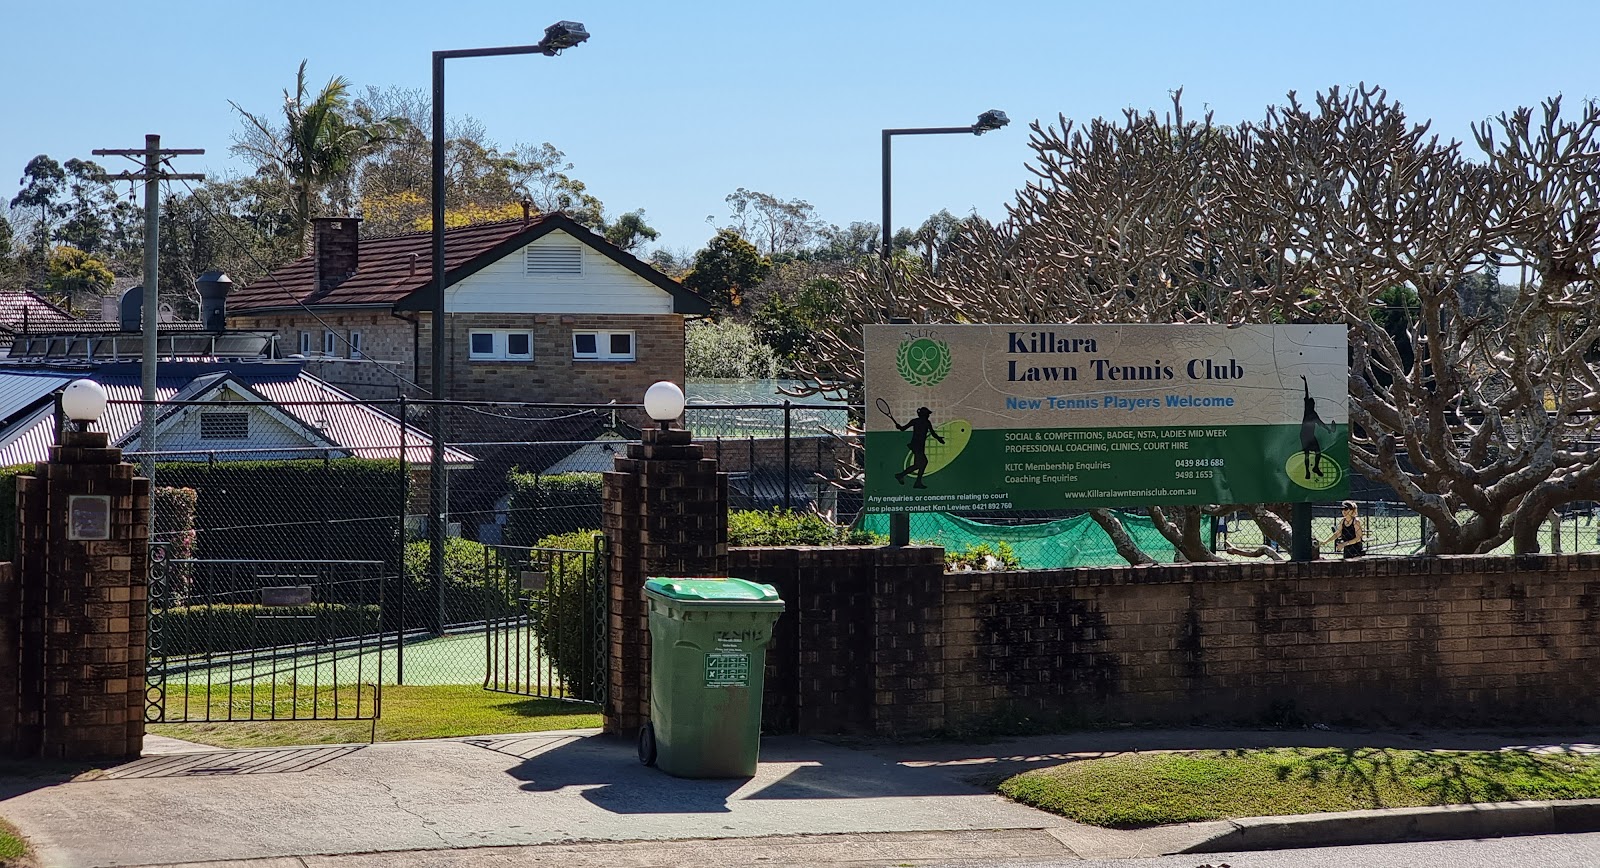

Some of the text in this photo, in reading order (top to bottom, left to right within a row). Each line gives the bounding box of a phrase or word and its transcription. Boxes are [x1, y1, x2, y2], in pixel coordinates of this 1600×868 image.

[1007, 332, 1098, 354] Killara
[1007, 358, 1244, 382] Lawn Tennis Club
[1006, 394, 1235, 412] New Tennis Players Welcome
[1005, 429, 1228, 441] SOCIAL & COMPETITIONS, BADGE, NSTA, LADIES MID WEEK
[1005, 441, 1189, 453] PROFESSIONAL COACHING, CLINICS, COURT HIRE
[1005, 461, 1111, 472] KLTC Membership Enquiries
[1175, 458, 1224, 468] 0439 843 688
[1005, 474, 1078, 484] Coaching Enquiries
[1175, 470, 1214, 479] 9498 1653
[868, 495, 881, 504] Any
[882, 494, 913, 503] enquiries
[923, 493, 956, 502] concerns
[956, 493, 981, 502] relating
[1065, 489, 1197, 498] www.Killaralawntennisclub.com.au
[880, 505, 904, 514] please
[904, 504, 931, 512] contact
[972, 503, 987, 511] 0421
[1000, 502, 1013, 510] 760
